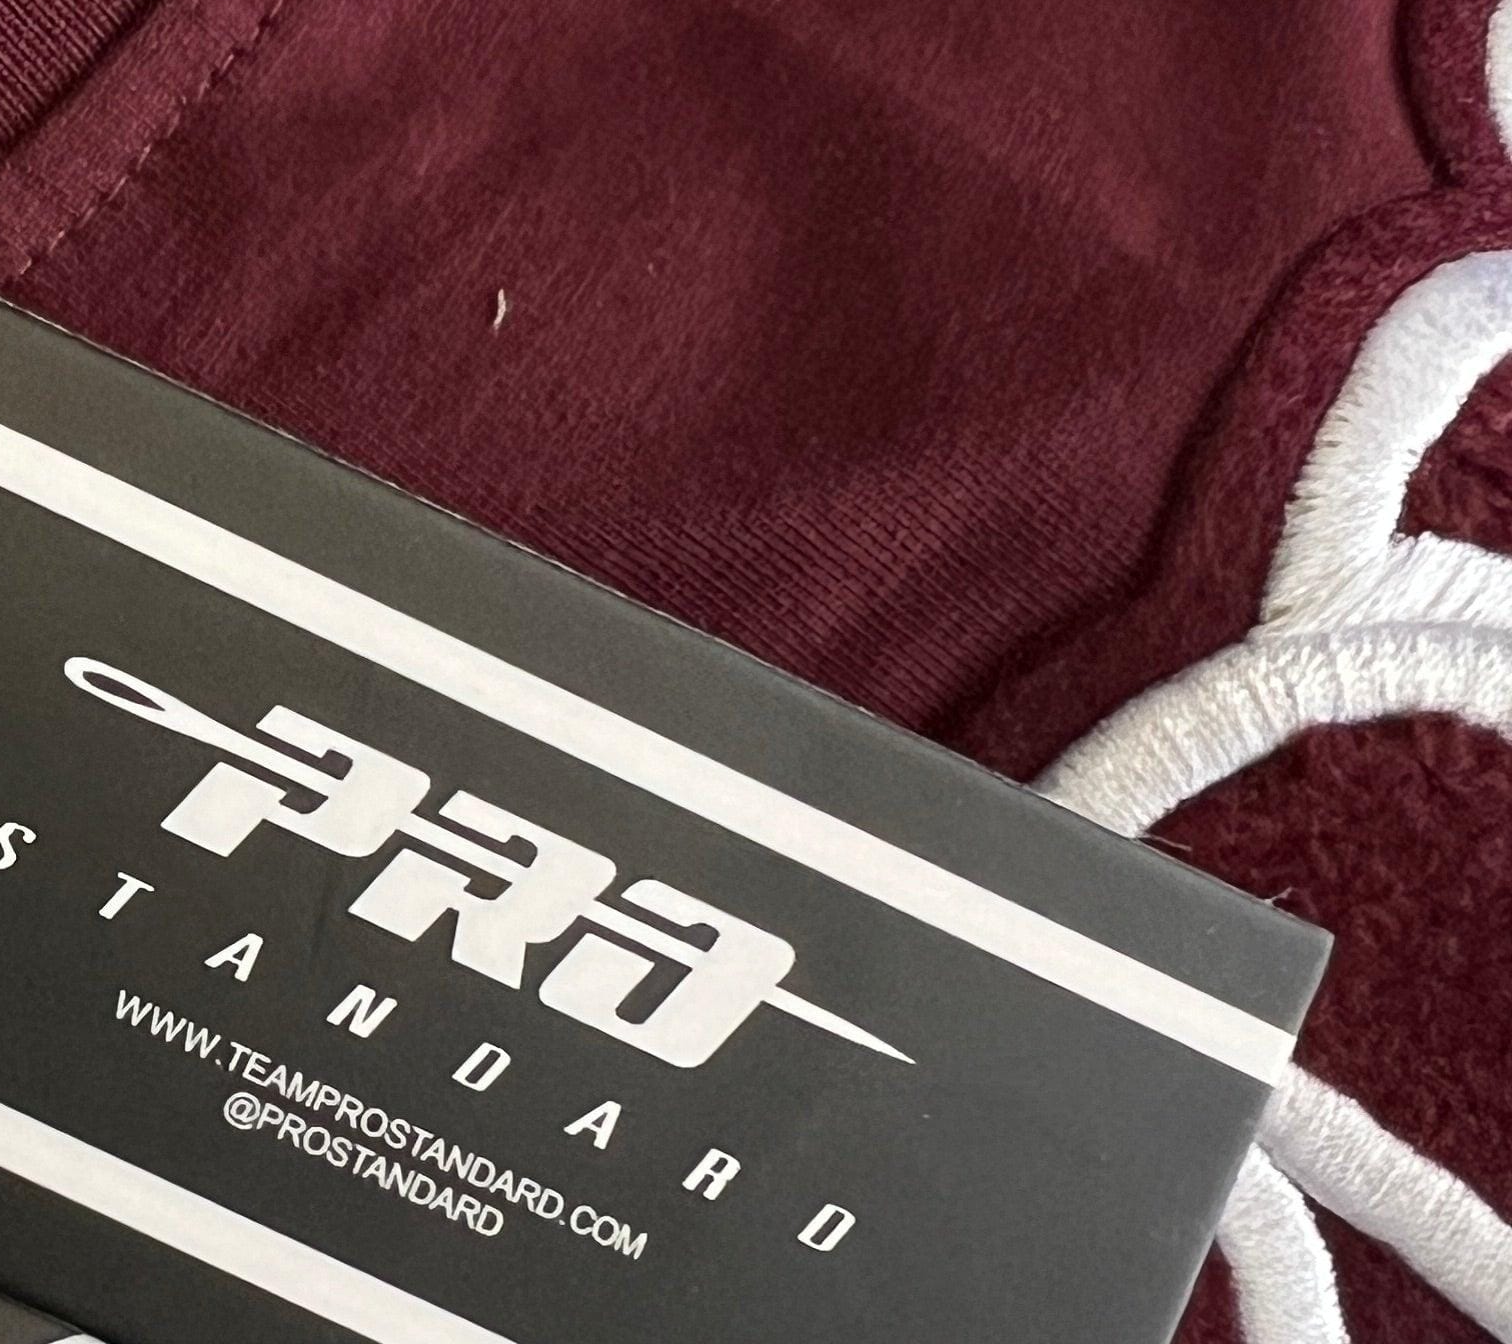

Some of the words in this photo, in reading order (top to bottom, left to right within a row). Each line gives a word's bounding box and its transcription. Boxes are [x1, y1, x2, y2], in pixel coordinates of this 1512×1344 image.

[160, 704, 797, 1069] PRO
[115, 989, 649, 1261] WWW.TEAMPROSTANDARD.COM
[223, 1091, 505, 1238] @PROSTANDARD
